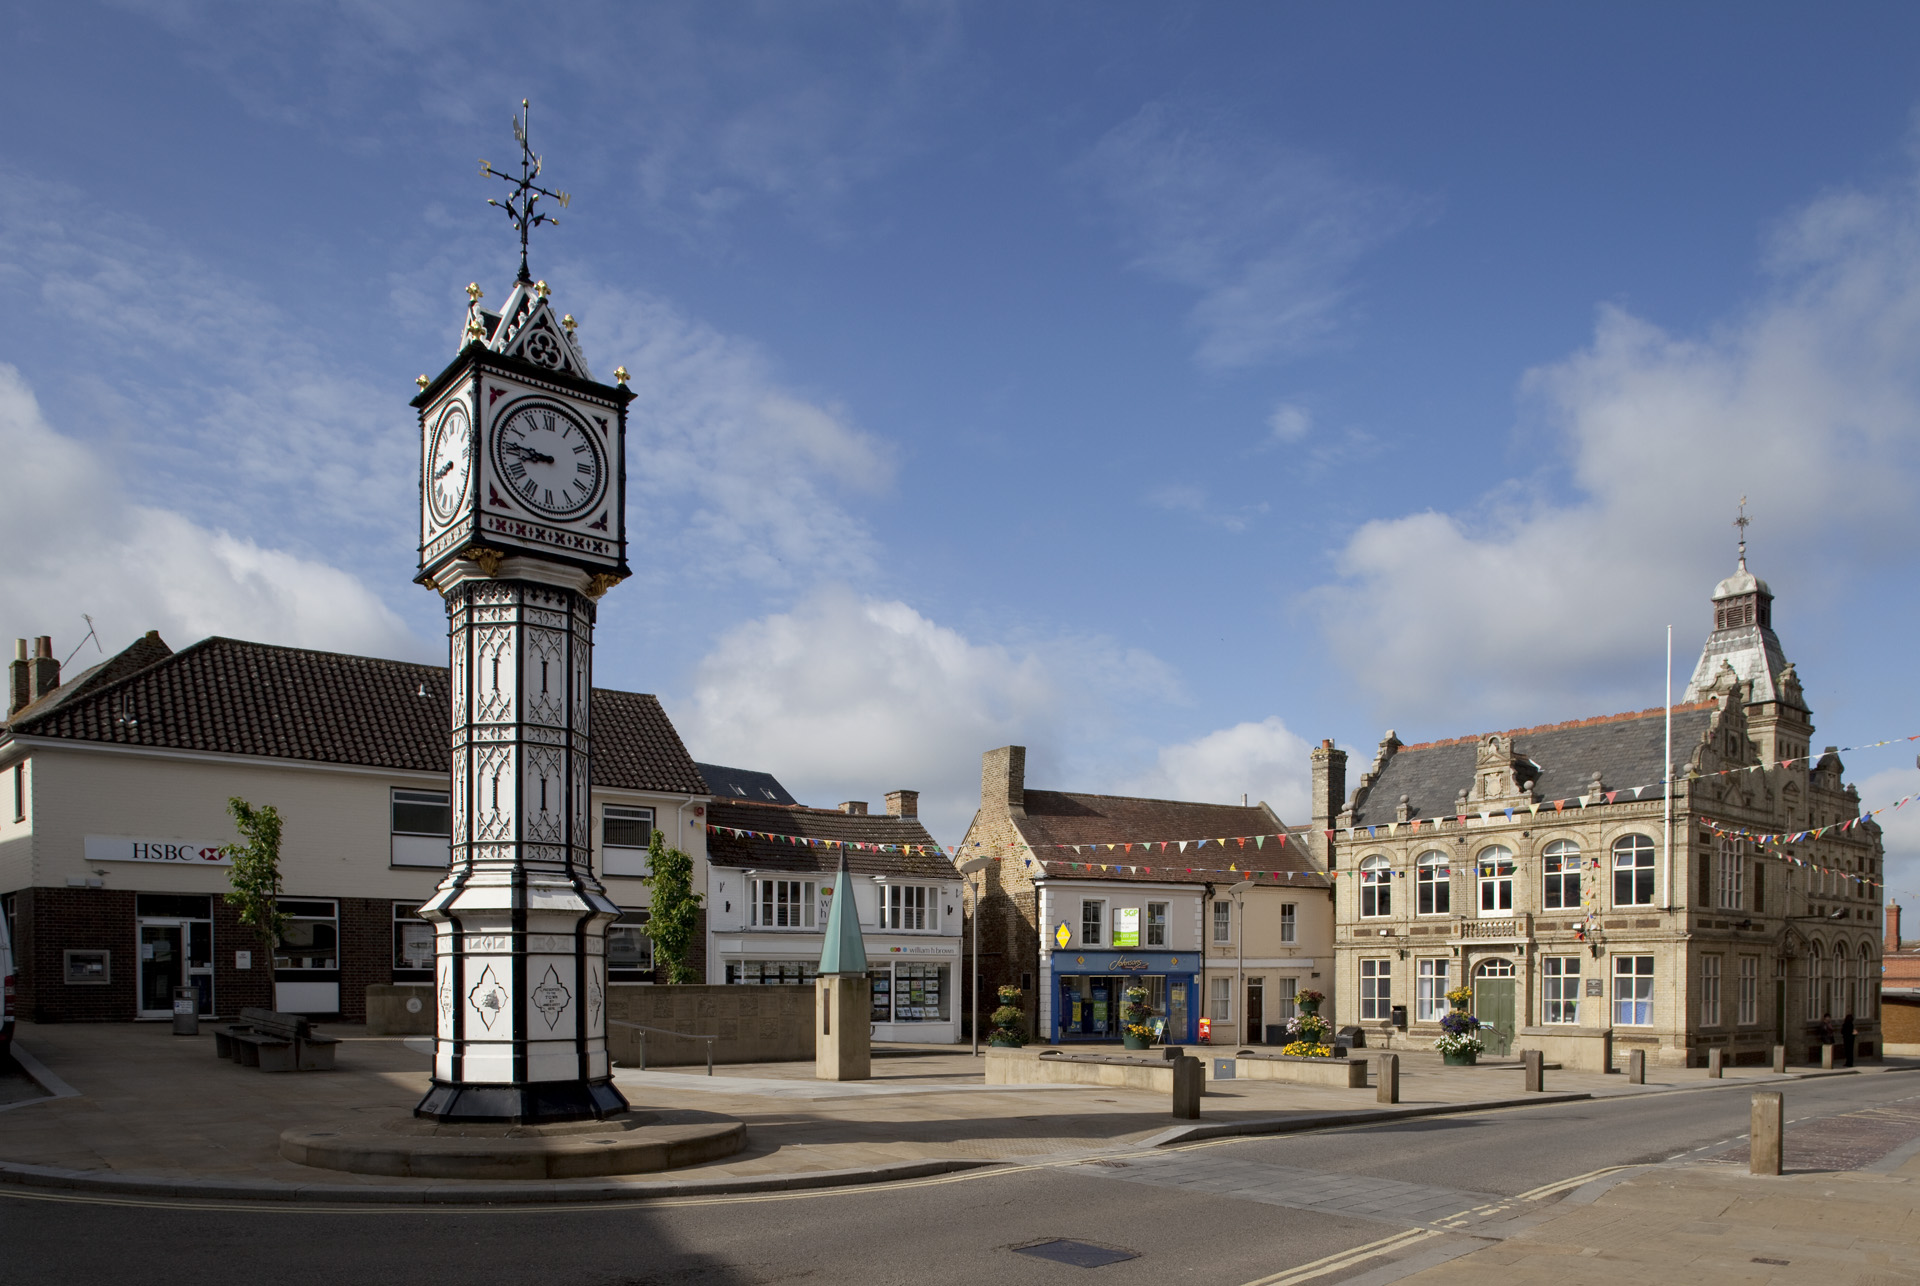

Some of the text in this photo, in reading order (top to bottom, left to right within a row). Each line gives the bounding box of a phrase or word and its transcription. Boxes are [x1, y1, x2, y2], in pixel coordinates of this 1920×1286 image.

[524, 415, 538, 431] XI
[543, 414, 556, 432] XII
[510, 425, 525, 440] X
[132, 843, 194, 861] HSBC
[1124, 909, 1138, 917] SGP
[910, 946, 931, 954] william
[1109, 955, 1142, 971] Johnsons
